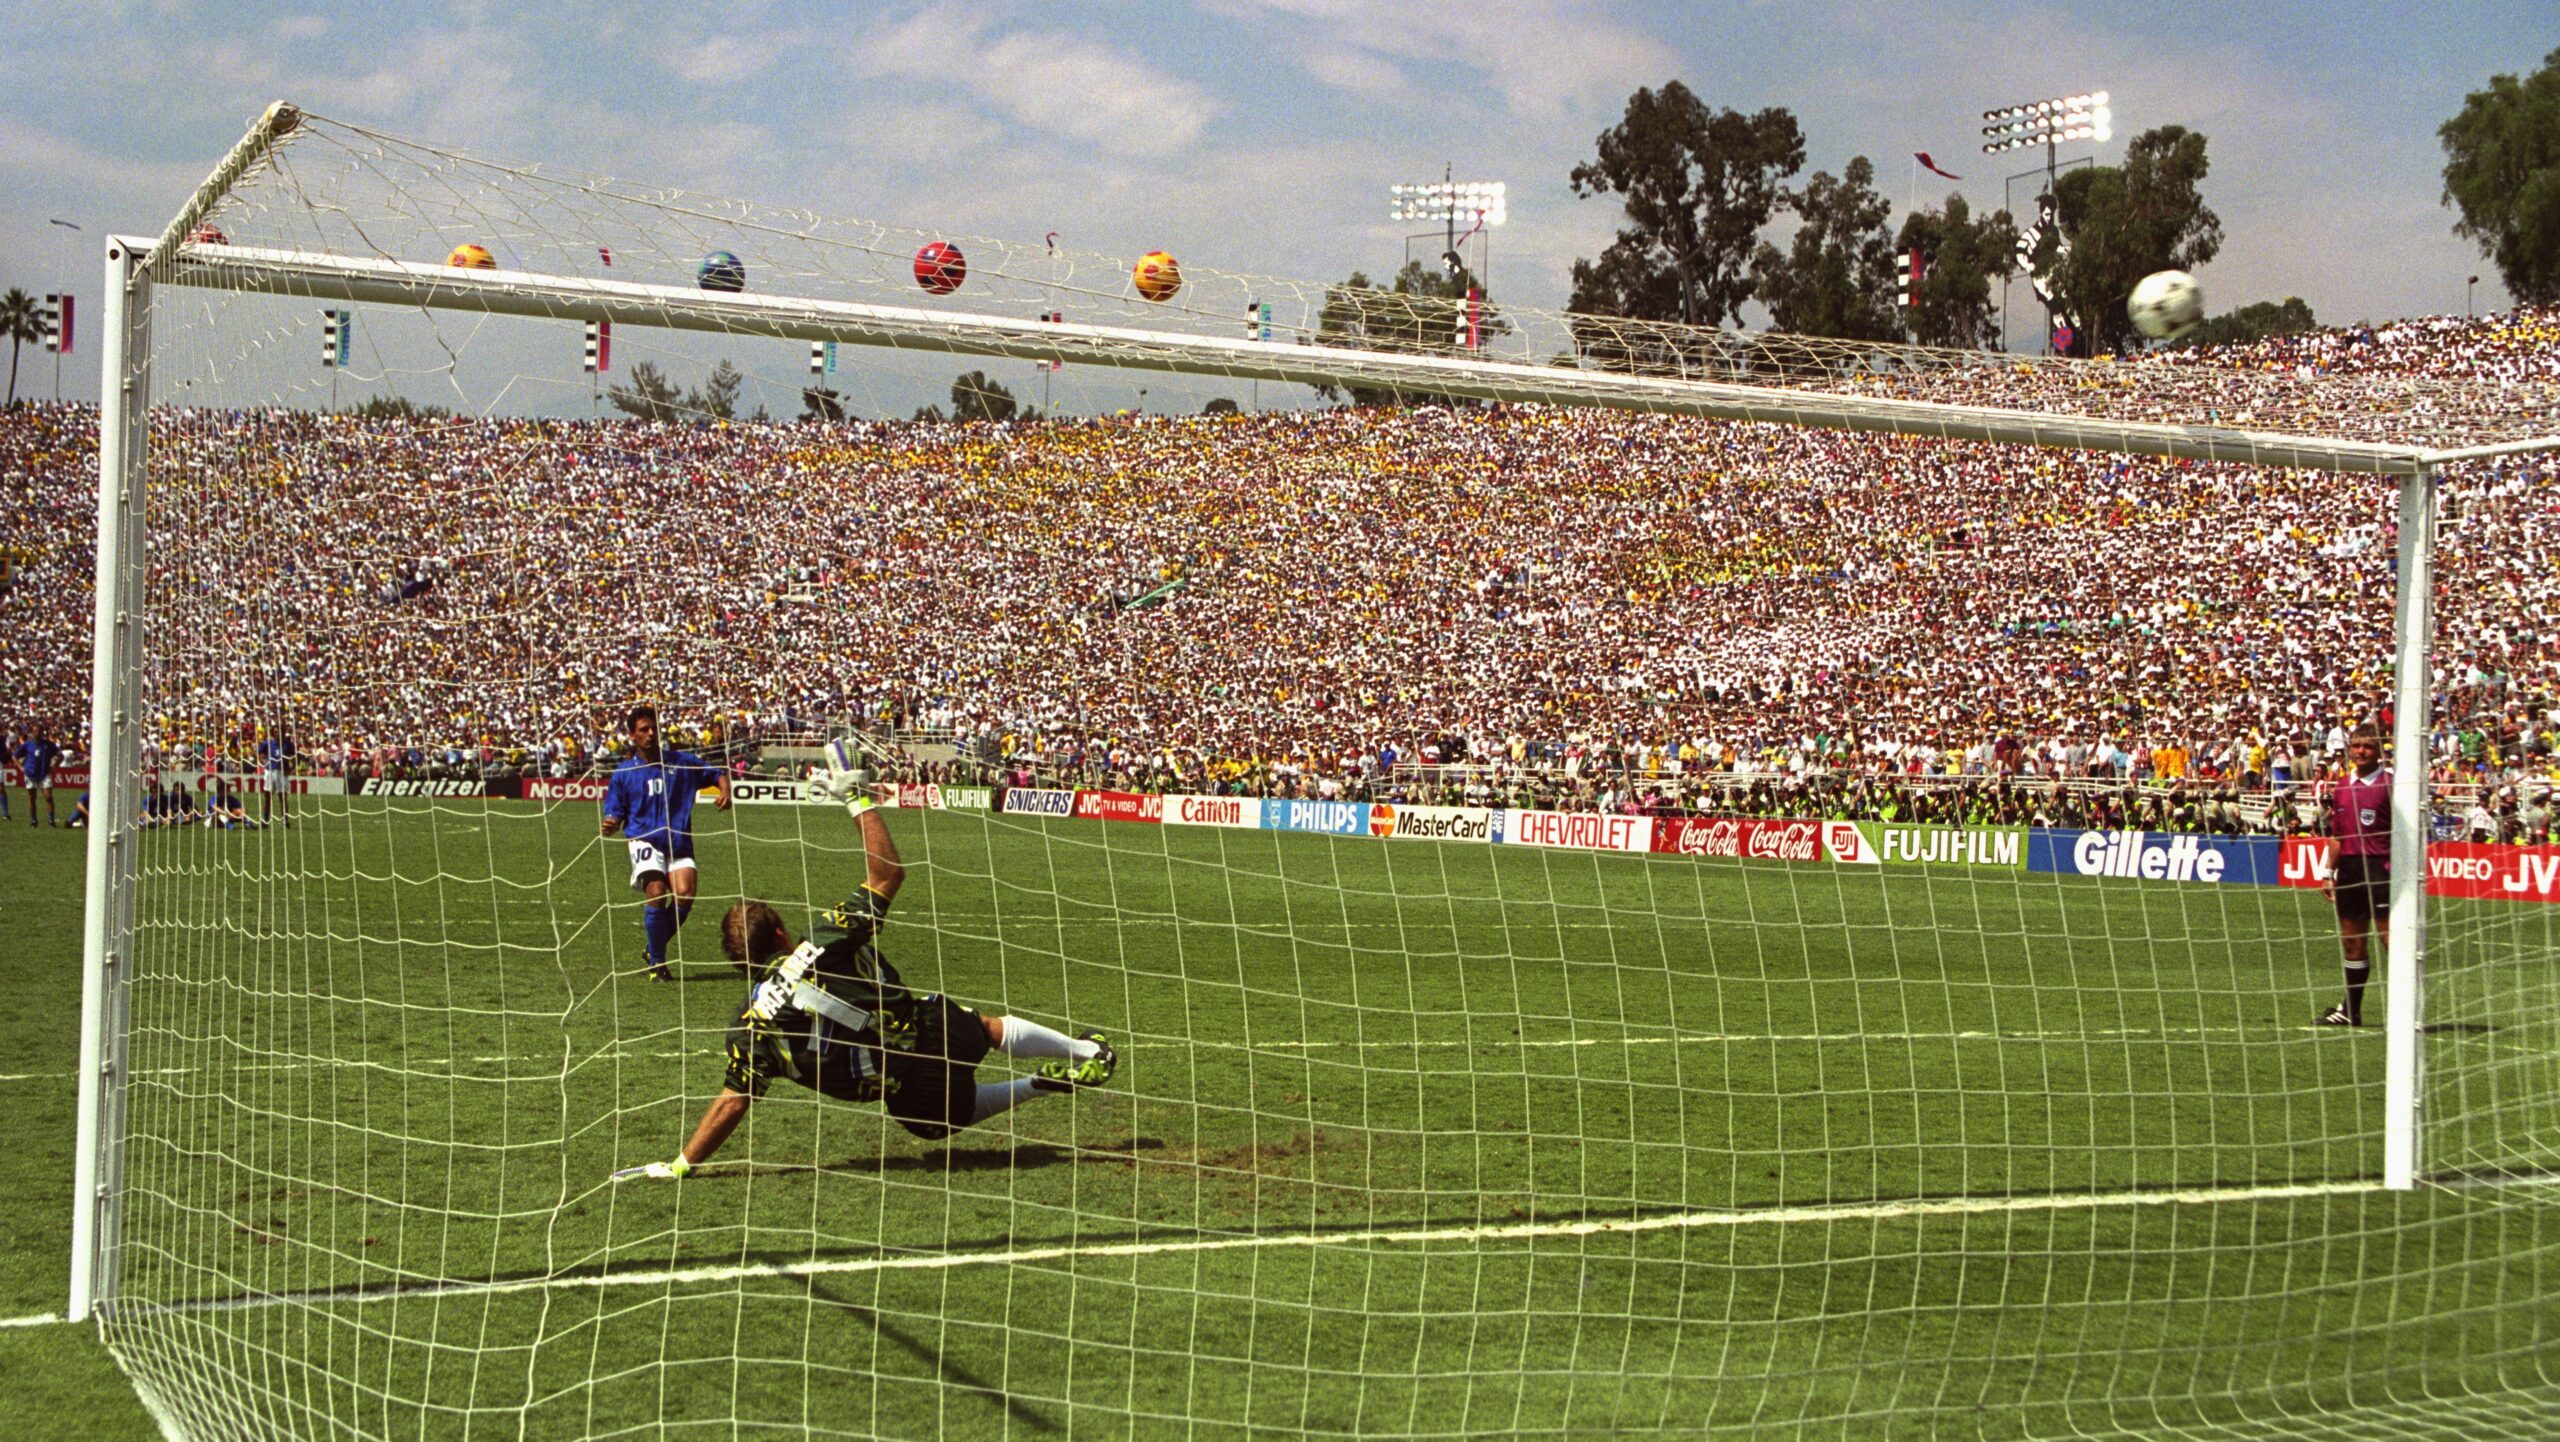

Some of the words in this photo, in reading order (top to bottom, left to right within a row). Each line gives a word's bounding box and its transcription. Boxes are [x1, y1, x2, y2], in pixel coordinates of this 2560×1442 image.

[197, 774, 308, 794] Cann
[360, 778, 486, 797] Energizer
[647, 778, 663, 796] 10
[733, 785, 806, 801] OPEL
[946, 789, 990, 809] FUJIFILM
[1006, 790, 1072, 814] SNICKERS
[1079, 794, 1100, 814] JVC
[1103, 800, 1111, 811] TV
[1112, 801, 1117, 811] &
[1117, 801, 1137, 813] VIDEO
[1139, 797, 1161, 818] JVC
[1181, 798, 1240, 824] Canon
[1290, 802, 1357, 832] PHILIPS
[1397, 811, 1489, 838] MasterCard
[1520, 813, 1635, 850] CHEVROLET
[1679, 820, 1741, 856] Coca-Cola
[1749, 822, 1817, 860] Coca-Cola
[635, 847, 652, 863] 10
[1883, 828, 2019, 865] FUJIFILM
[2074, 831, 2224, 882] Gillette
[2284, 844, 2338, 881] JV
[2429, 857, 2492, 880] VIDEO
[2503, 854, 2560, 894] JV
